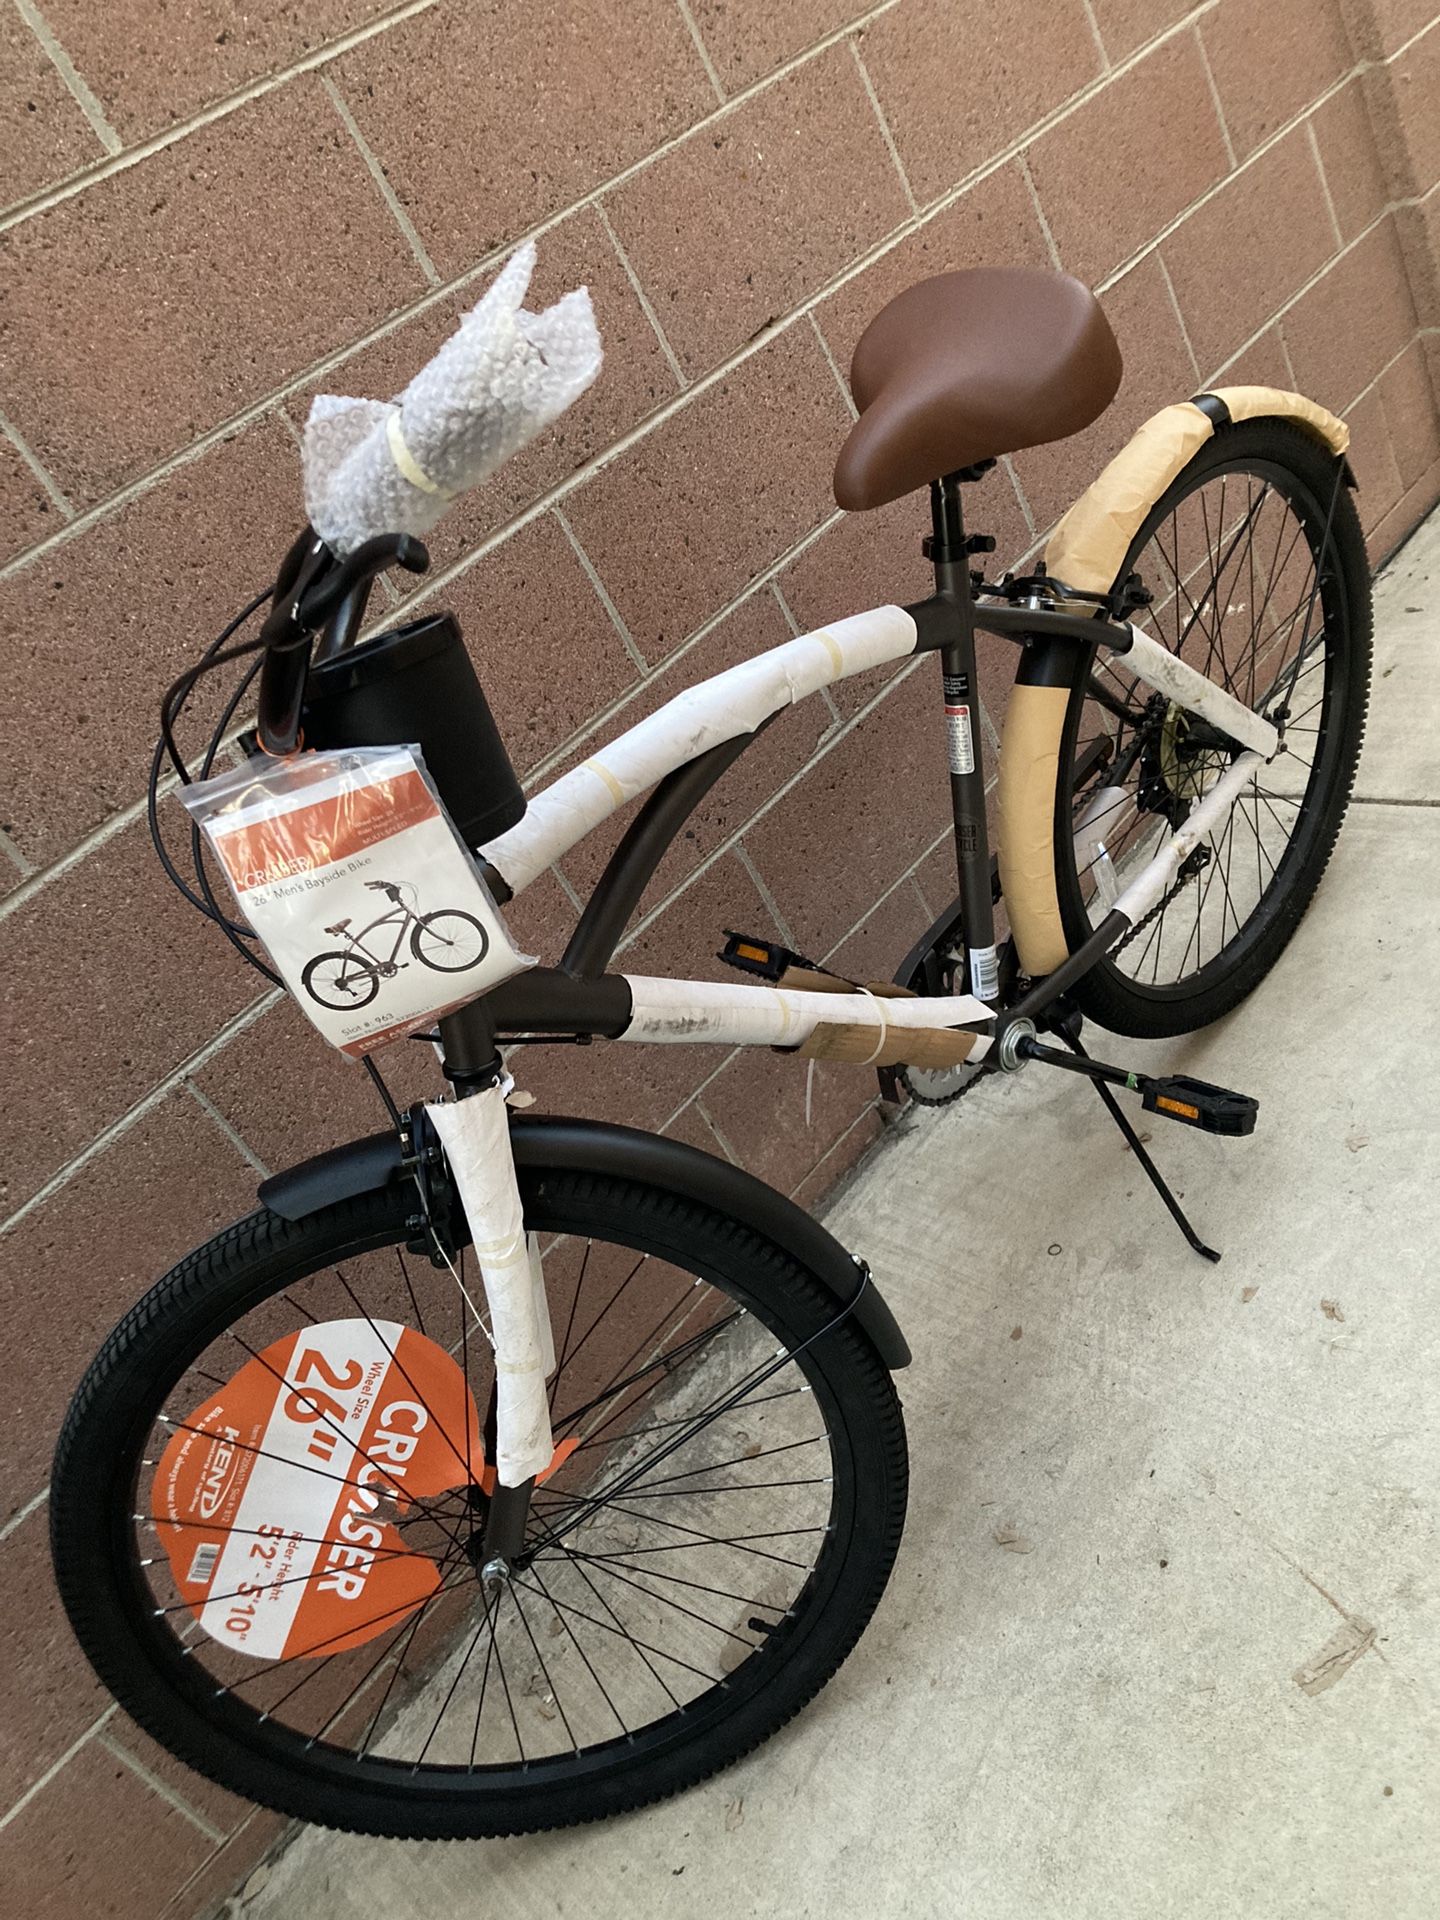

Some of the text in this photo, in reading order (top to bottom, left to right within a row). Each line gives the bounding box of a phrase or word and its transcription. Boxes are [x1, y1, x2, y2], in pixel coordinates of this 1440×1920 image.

[305, 866, 346, 889] Bayside
[348, 855, 372, 872] Bike
[341, 1024, 361, 1036] Slot
[374, 1012, 394, 1024] 963
[350, 1361, 384, 1420] Wheel Size
[179, 1438, 192, 1455] and
[202, 1434, 219, 1470] entury
[199, 1425, 240, 1508] KENT
[282, 1530, 304, 1561] Rder
